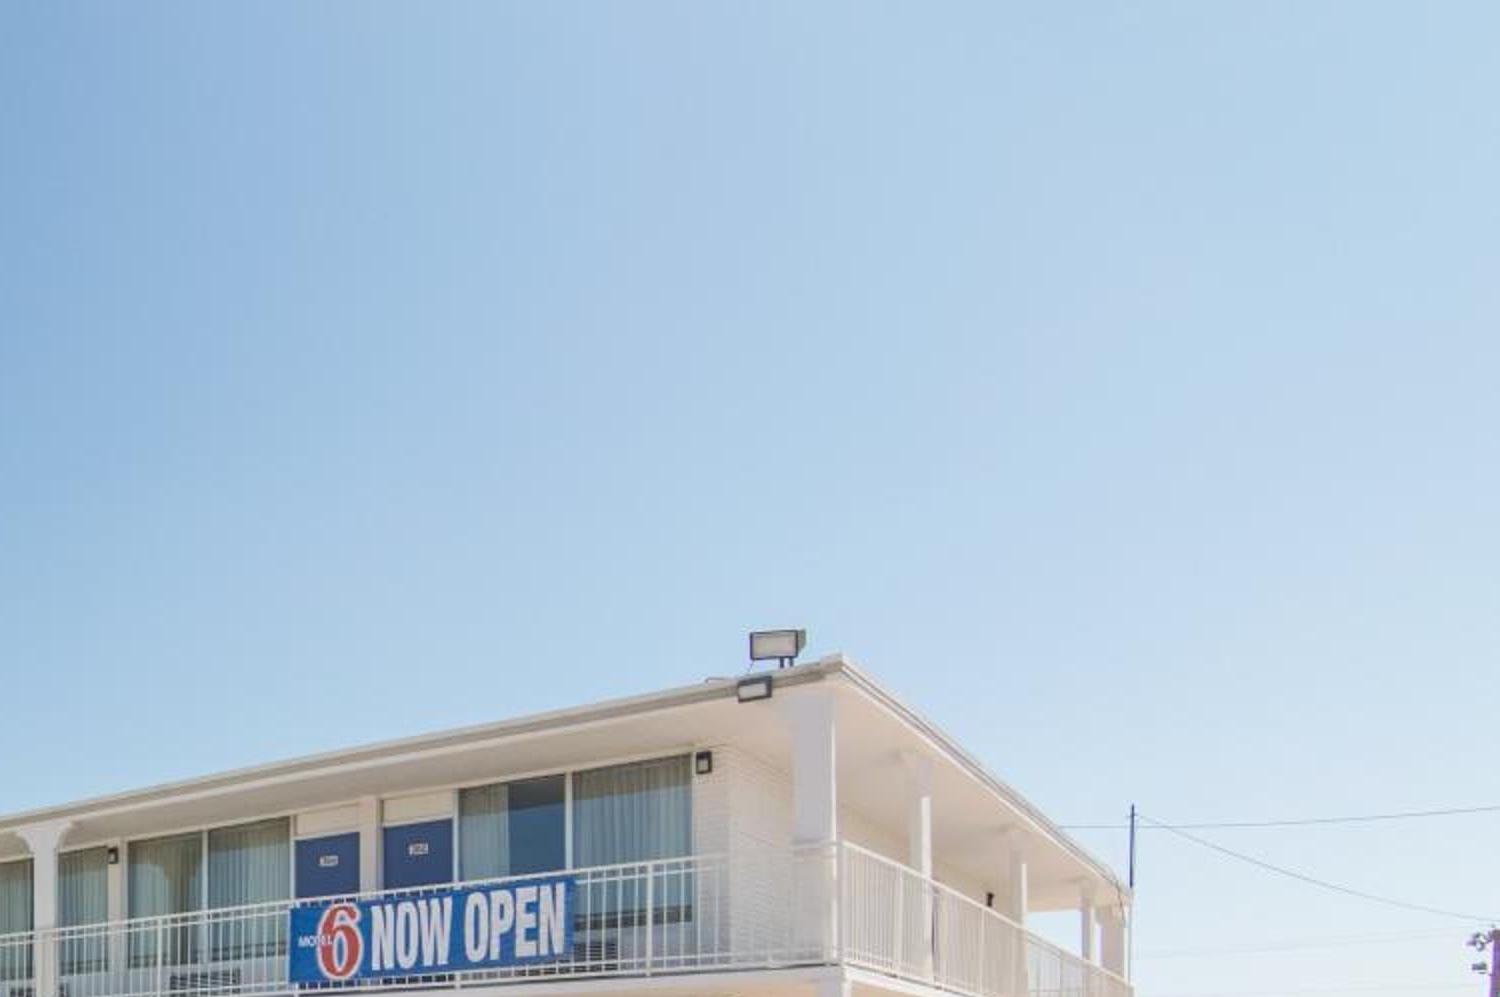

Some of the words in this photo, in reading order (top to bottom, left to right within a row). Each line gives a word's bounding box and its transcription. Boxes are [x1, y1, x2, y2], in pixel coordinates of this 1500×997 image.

[297, 933, 333, 948] MOTEL
[317, 902, 364, 980] 6
[370, 896, 453, 971] NOW
[463, 881, 566, 963] OPEN
